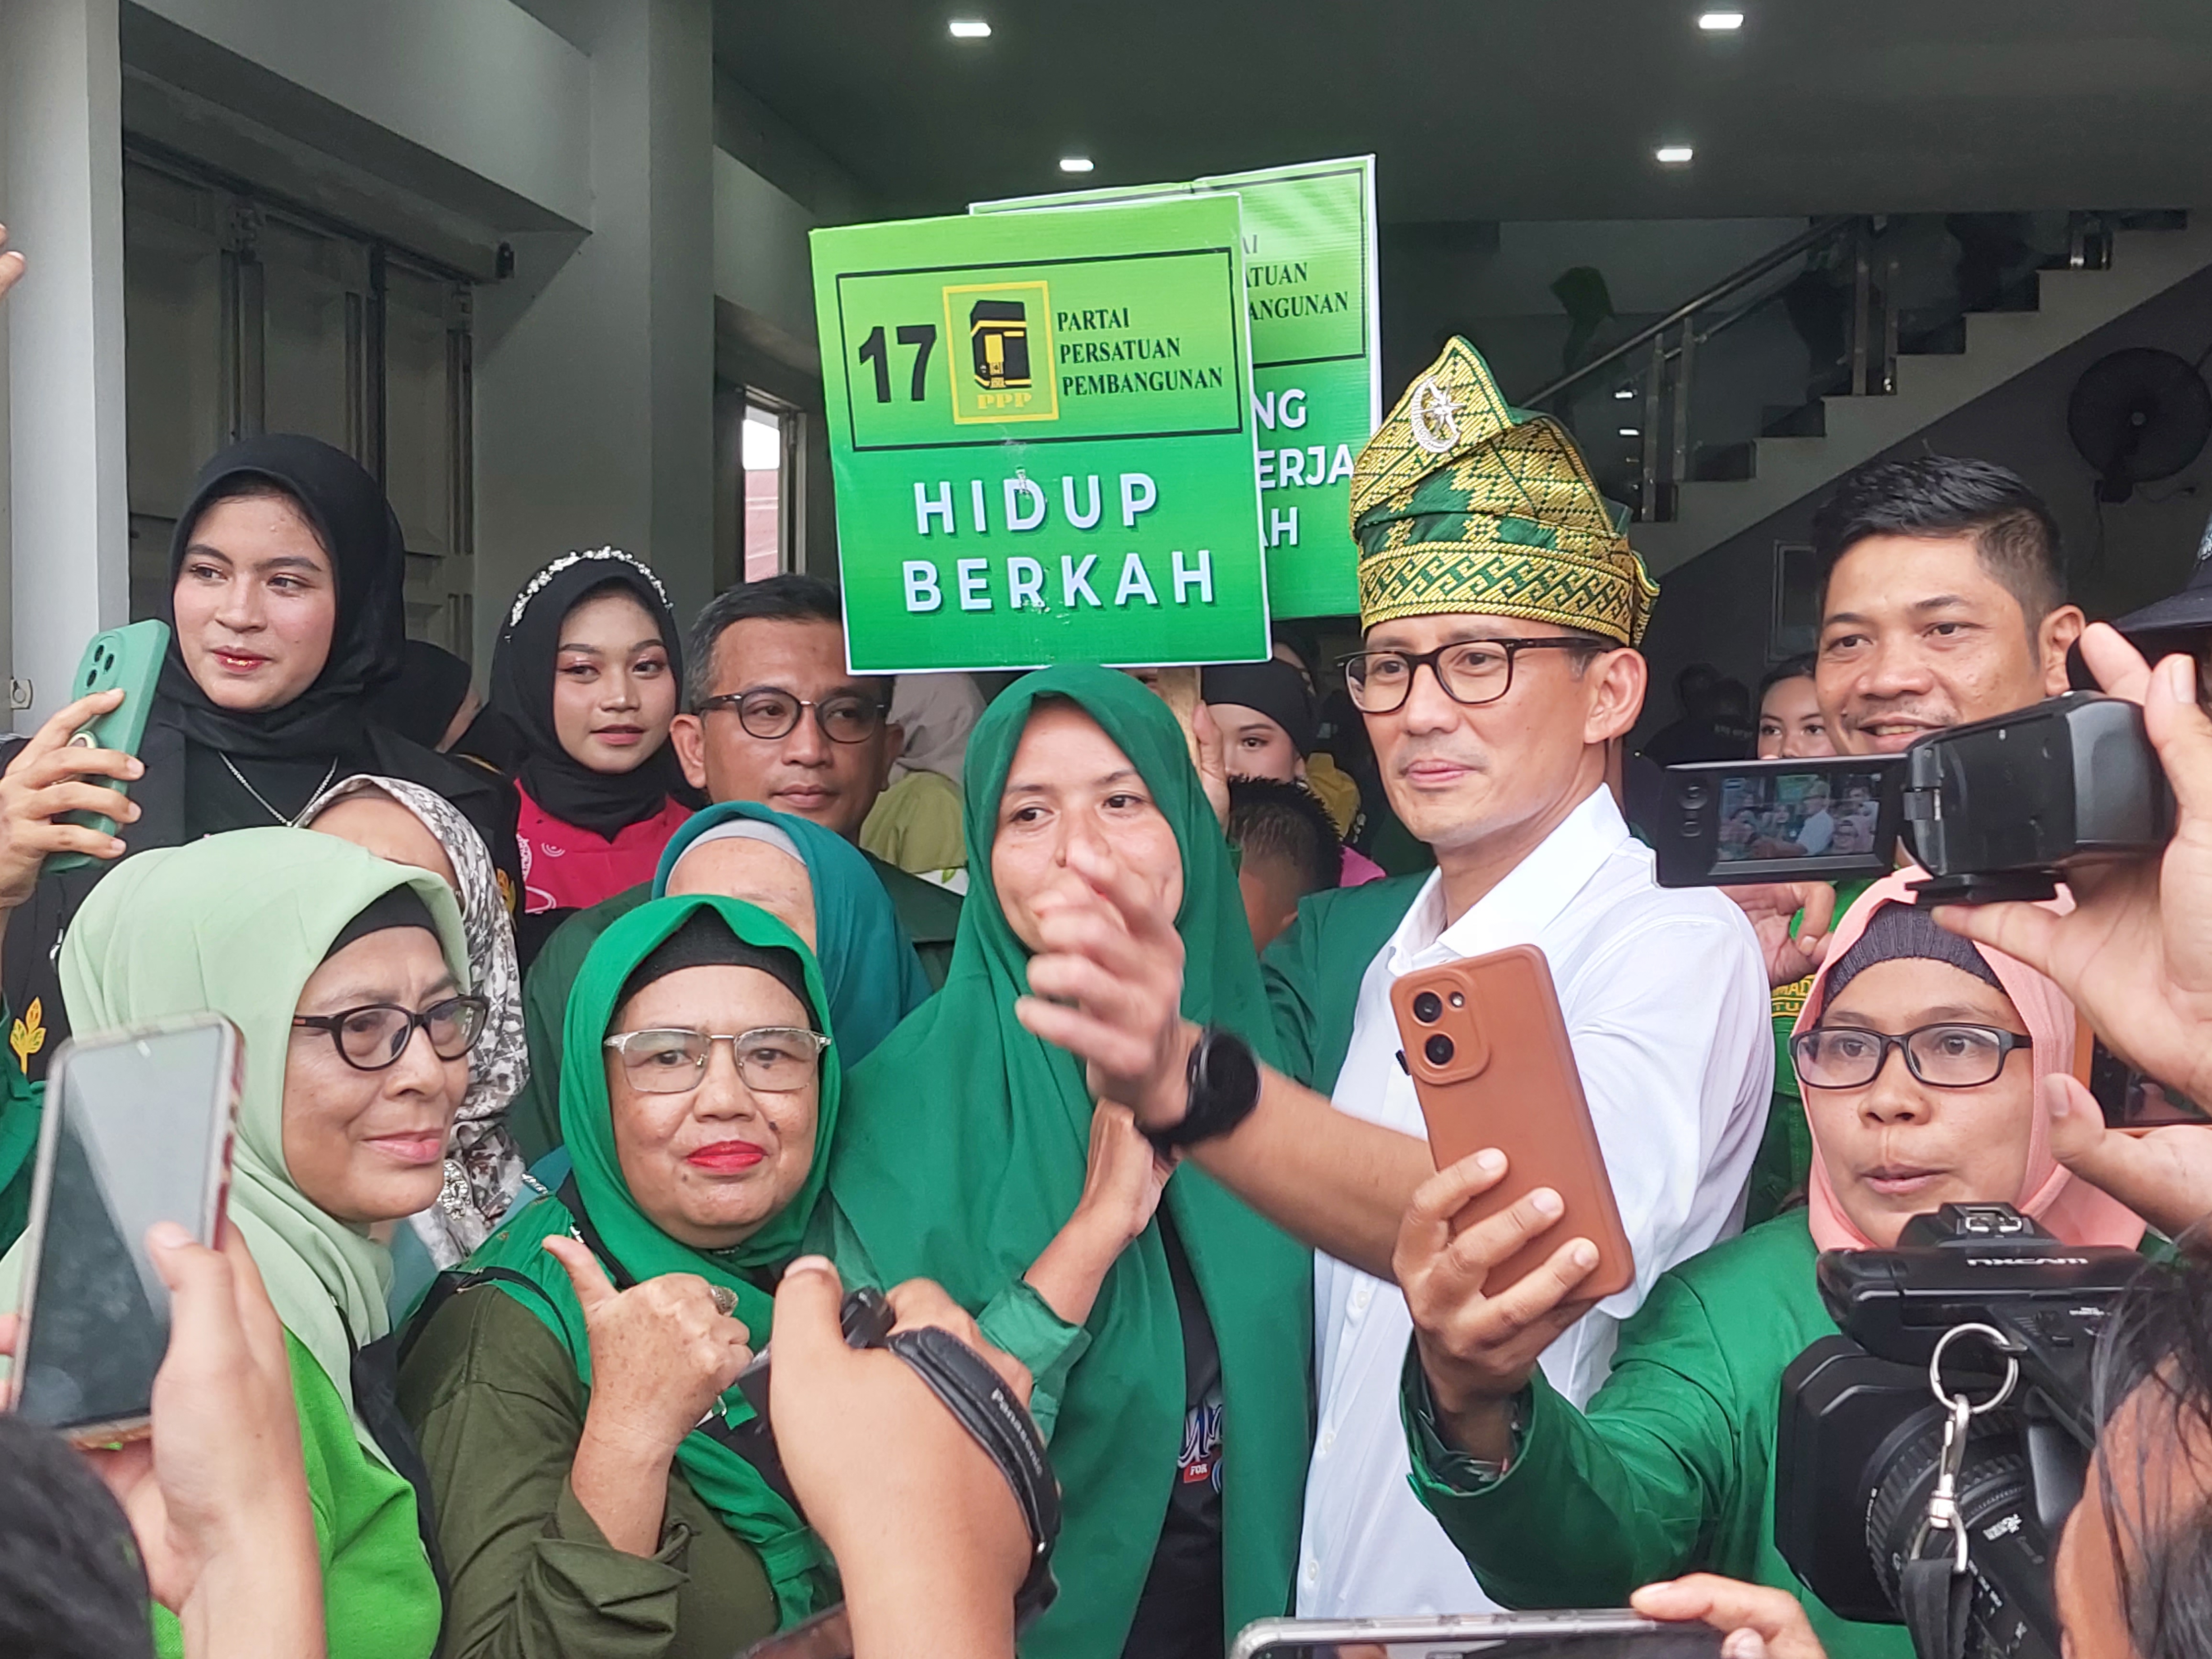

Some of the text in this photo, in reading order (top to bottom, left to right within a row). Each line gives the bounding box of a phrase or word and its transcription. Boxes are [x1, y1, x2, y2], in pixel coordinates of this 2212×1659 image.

[1057, 308, 1129, 332] PARTAI
[1249, 291, 1348, 320] ANGUNAN
[859, 324, 937, 403] 17
[1060, 338, 1180, 364] PERSATUAN
[978, 393, 1031, 409] PPP
[1062, 367, 1223, 396] PEMBANGUNAN
[1253, 388, 1306, 430] NG
[1258, 444, 1355, 488] ERJA
[914, 473, 1158, 534] HIDUP
[1262, 507, 1298, 547] H
[903, 550, 1213, 612] BERKAH
[991, 1388, 1043, 1478] Panasonic
[1190, 1463, 1208, 1476] FOR
